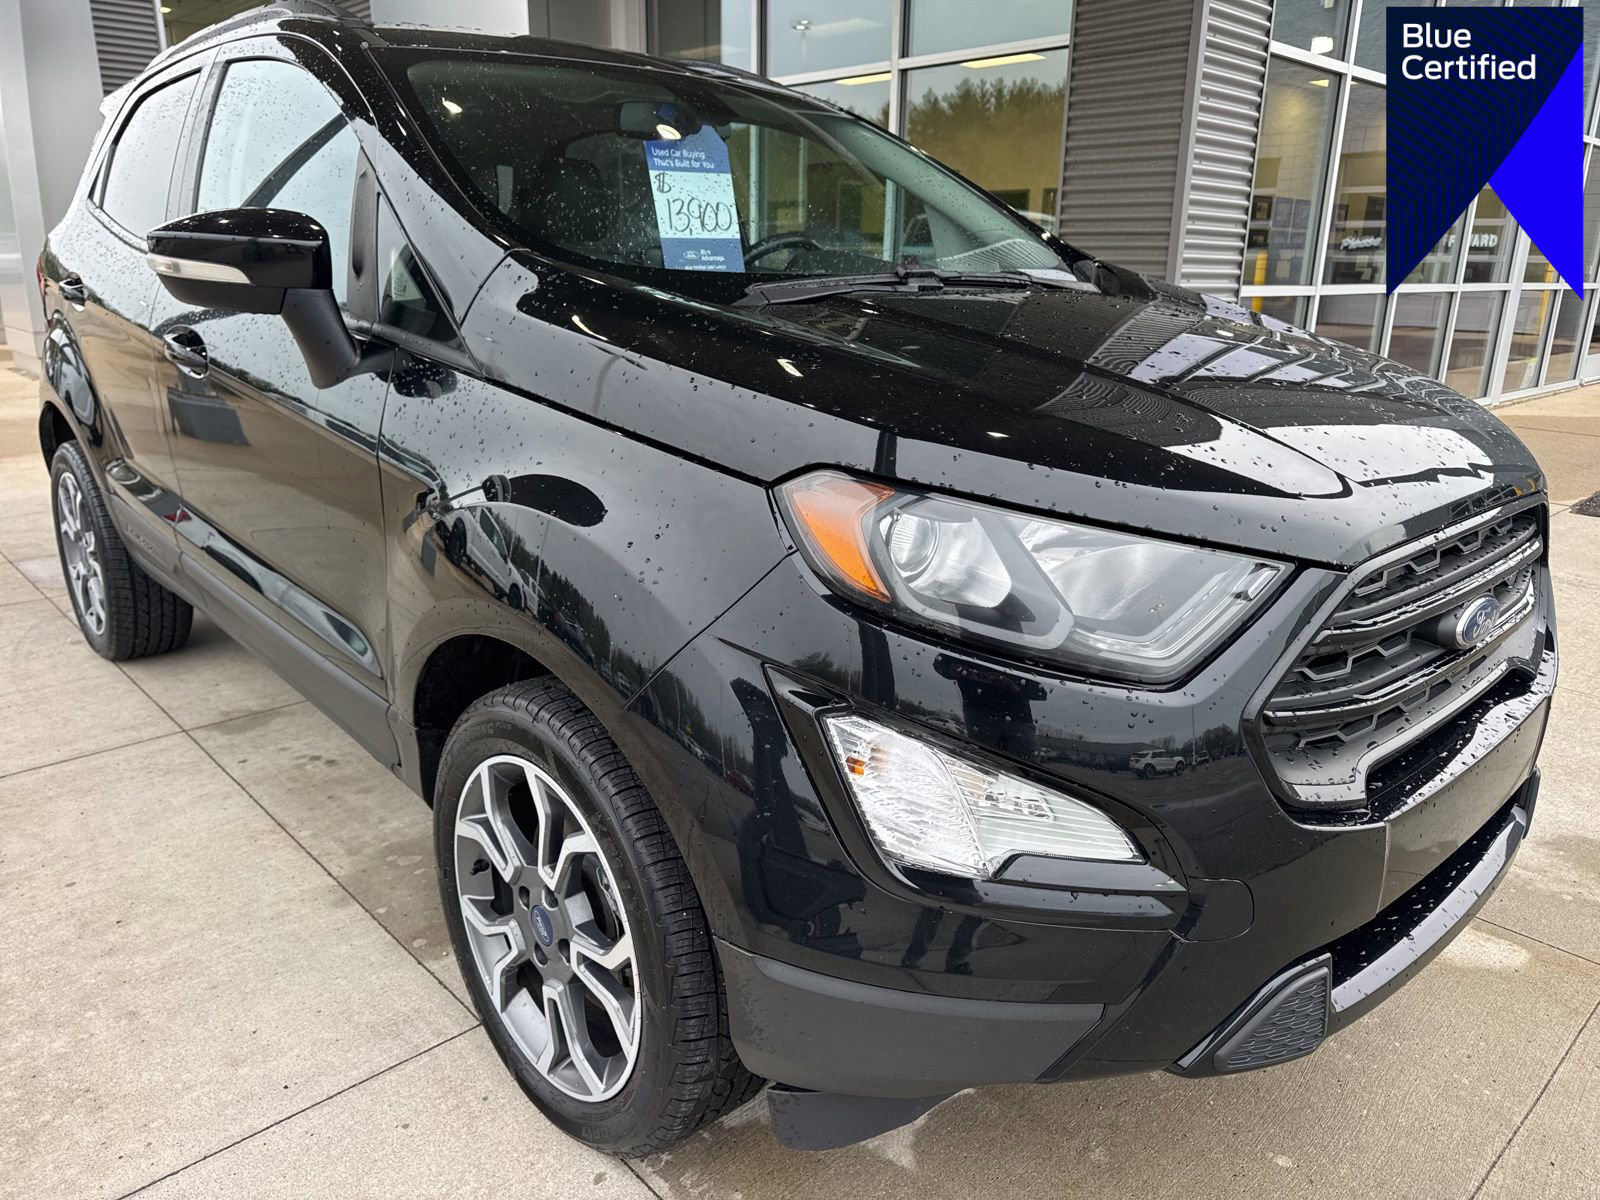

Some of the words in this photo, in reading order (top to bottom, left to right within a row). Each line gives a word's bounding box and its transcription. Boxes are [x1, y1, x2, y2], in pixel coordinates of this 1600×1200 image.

[651, 146, 669, 157] Used
[670, 149, 680, 157] Car
[682, 149, 705, 160] Buying
[654, 157, 674, 167] That's
[675, 159, 690, 168] Built
[691, 160, 700, 168] for
[702, 161, 715, 169] You
[655, 171, 672, 193] $
[666, 196, 732, 236] 13,900
[1473, 606, 1498, 639] Ford
